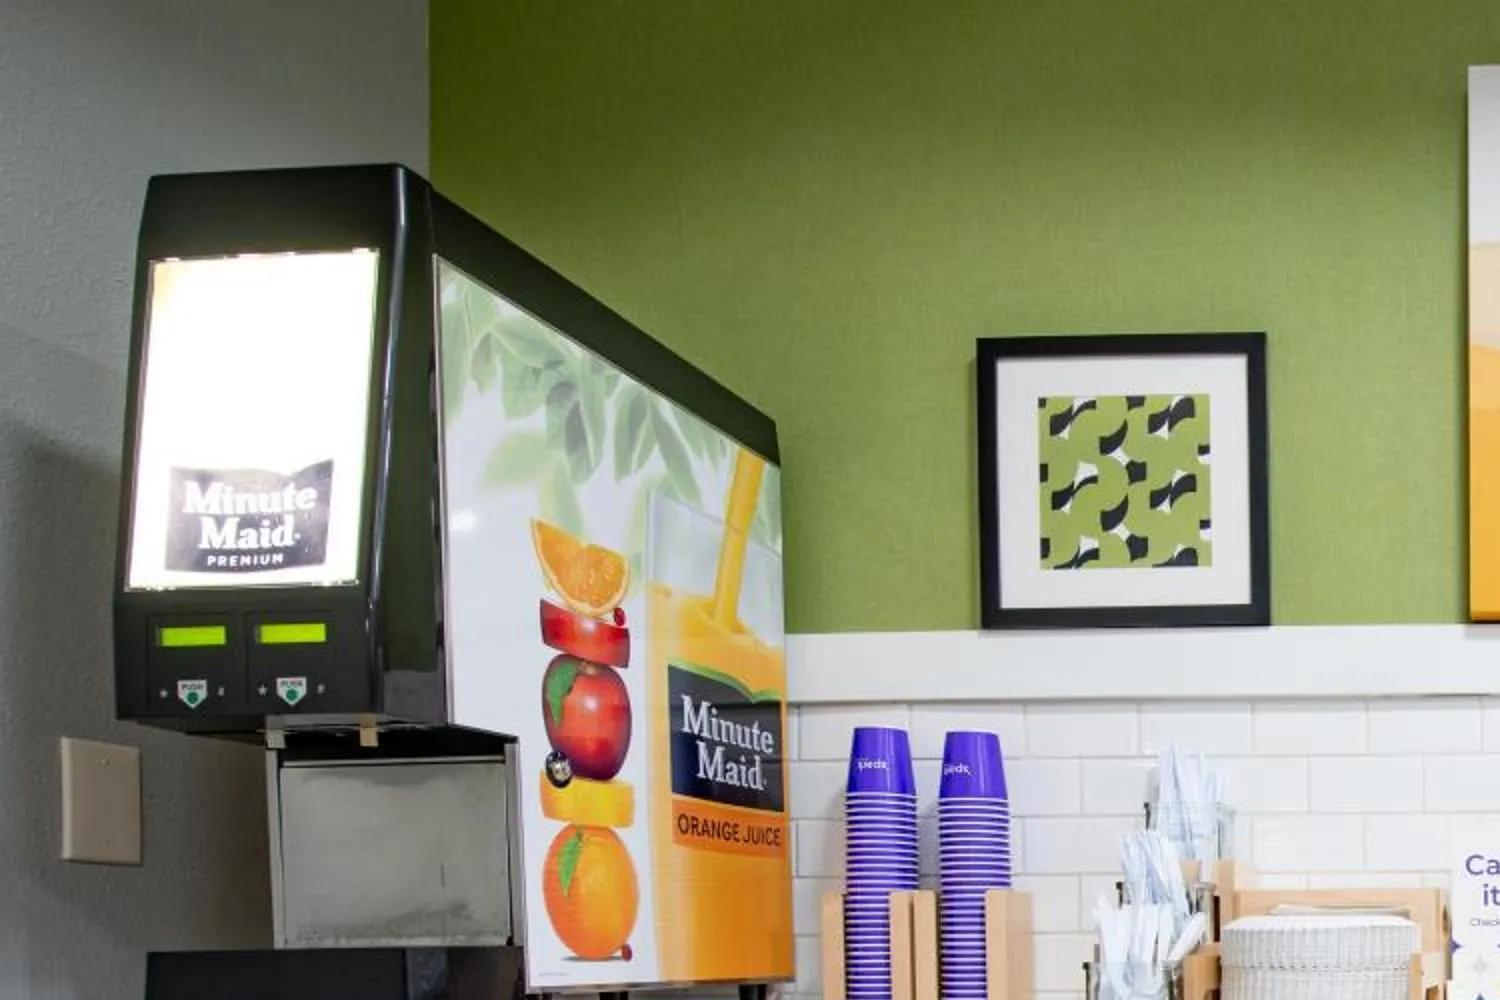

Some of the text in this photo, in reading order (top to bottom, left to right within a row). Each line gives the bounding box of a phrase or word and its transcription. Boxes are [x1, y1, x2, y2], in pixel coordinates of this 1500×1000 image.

[182, 479, 318, 515] Minute
[198, 513, 296, 550] Maid
[207, 553, 285, 568] PREMIUM
[681, 693, 775, 754] Minute
[695, 738, 765, 791] Maid
[677, 813, 781, 846] ORANGE JUICE
[1483, 883, 1500, 906] it
